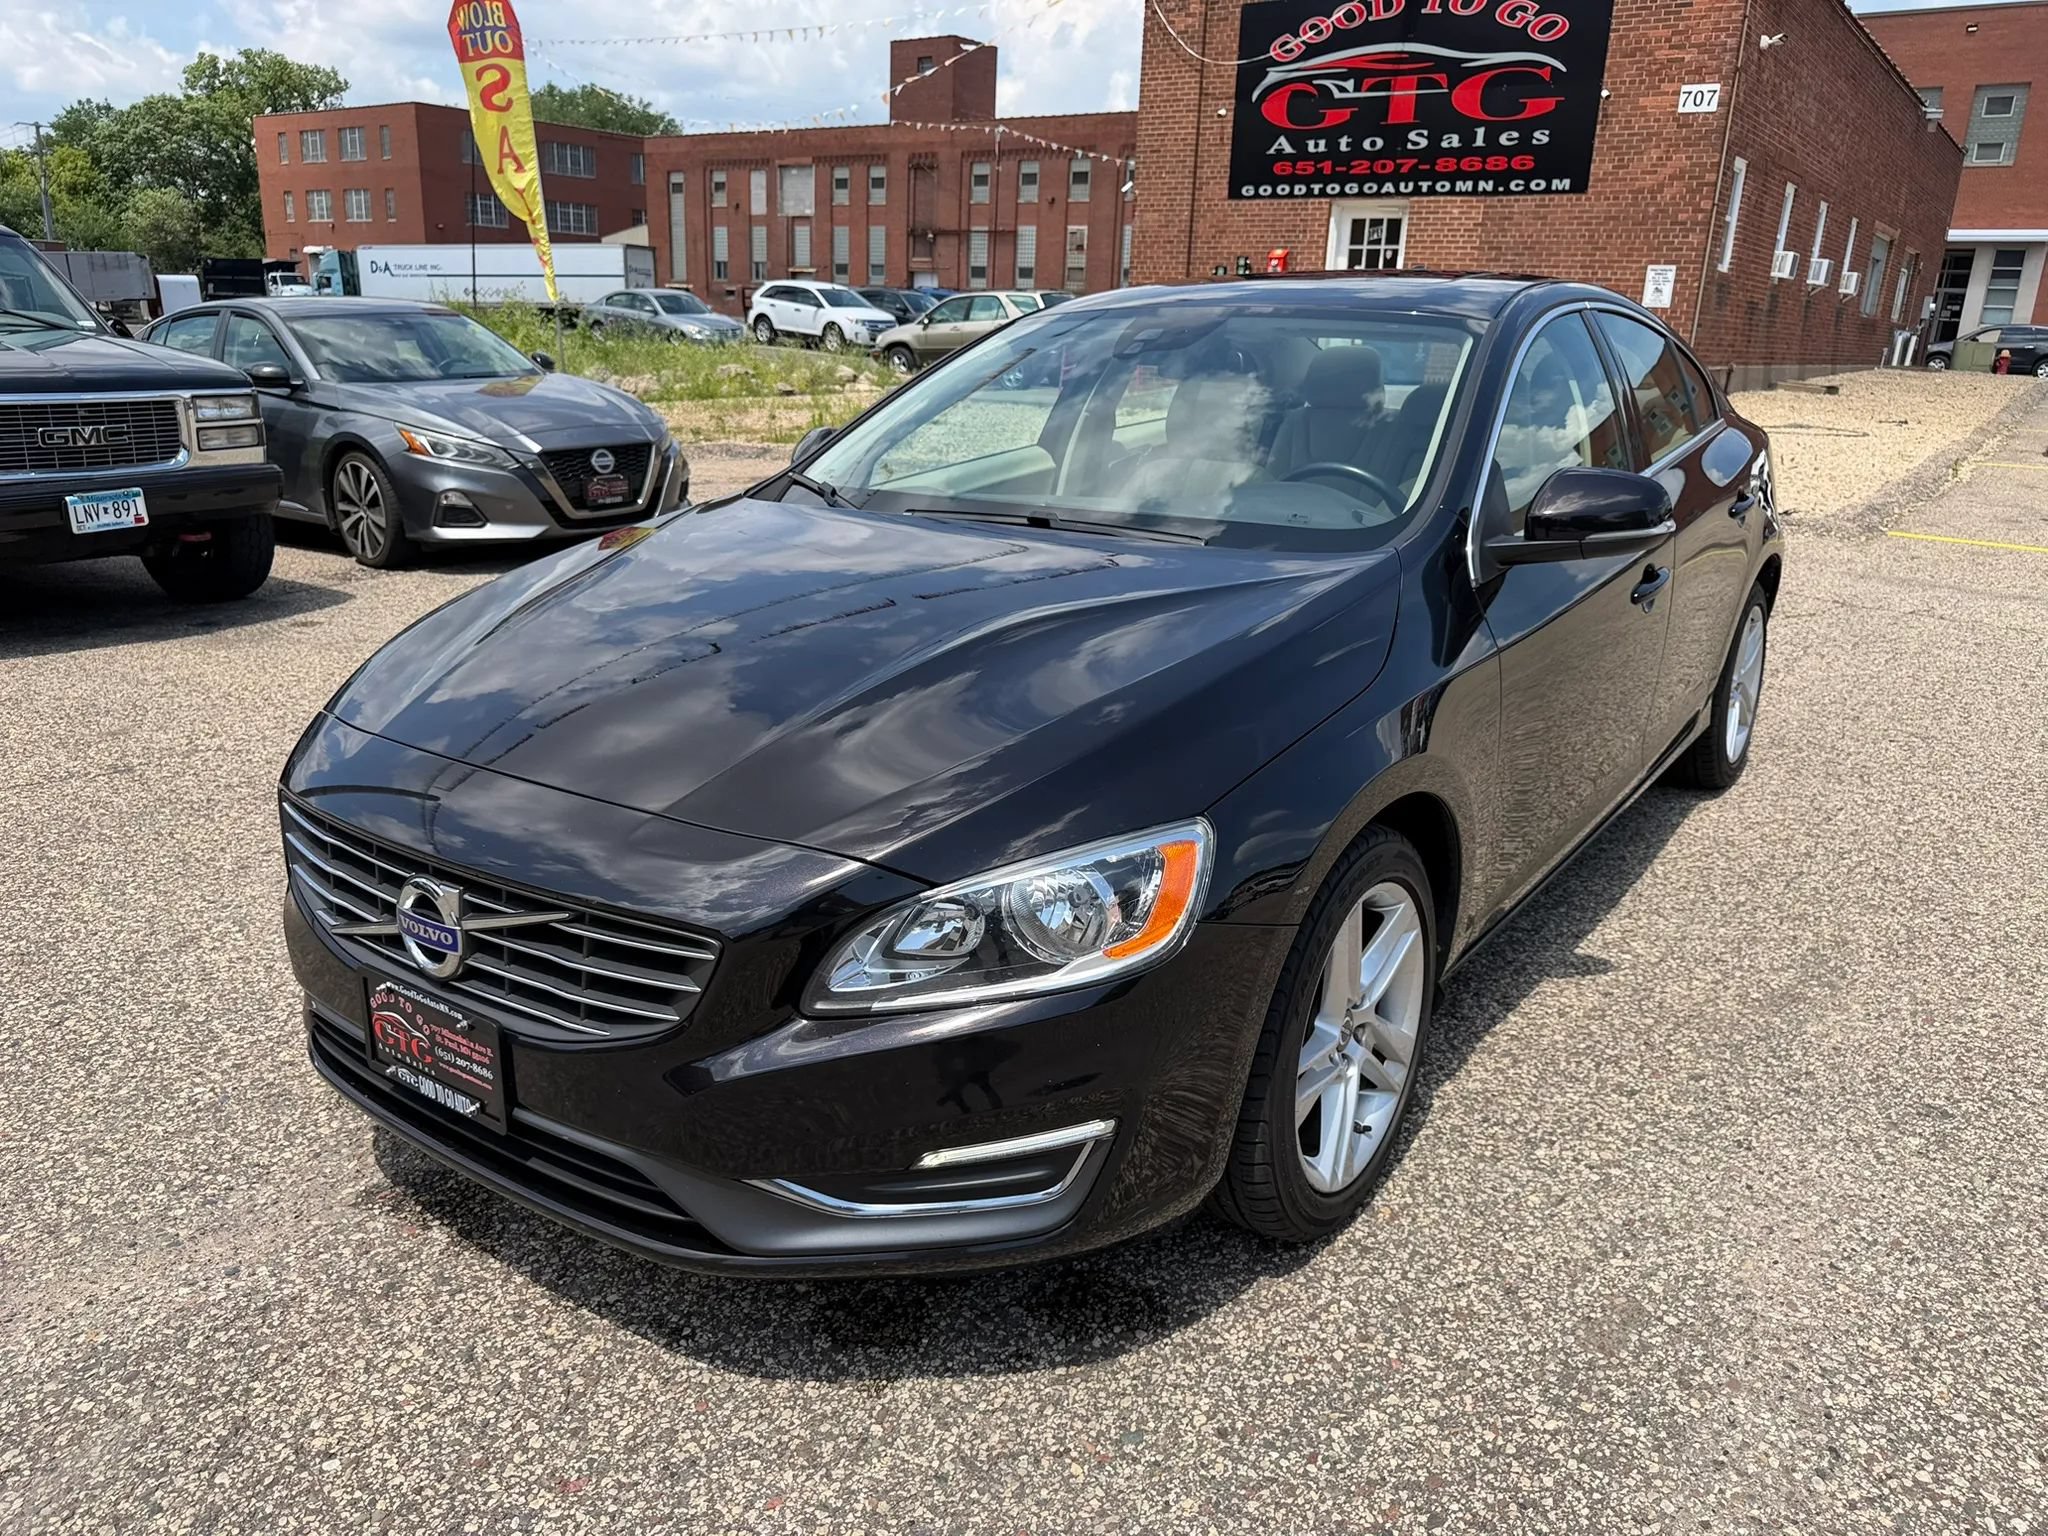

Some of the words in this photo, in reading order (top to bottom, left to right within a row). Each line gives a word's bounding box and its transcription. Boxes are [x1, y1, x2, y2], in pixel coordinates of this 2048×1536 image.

[1270, 0, 1405, 62] GOOD
[1495, 0, 1570, 42] GO
[1261, 66, 1566, 130] GTG
[1682, 90, 1718, 108] 707
[1265, 134, 1385, 155] Auto
[1406, 126, 1551, 150] Sales
[1272, 155, 1536, 176] 651-207-8686
[1241, 178, 1571, 197] GOODTOGOAUTOMN.COM
[38, 424, 129, 448] GMC
[73, 503, 101, 524] LNV
[112, 499, 143, 519] 891
[400, 914, 453, 945] VOLVO
[370, 991, 395, 1009] GOOD
[398, 996, 412, 1013] TO
[434, 1045, 455, 1063] (651)
[455, 1056, 493, 1080] 207-8686
